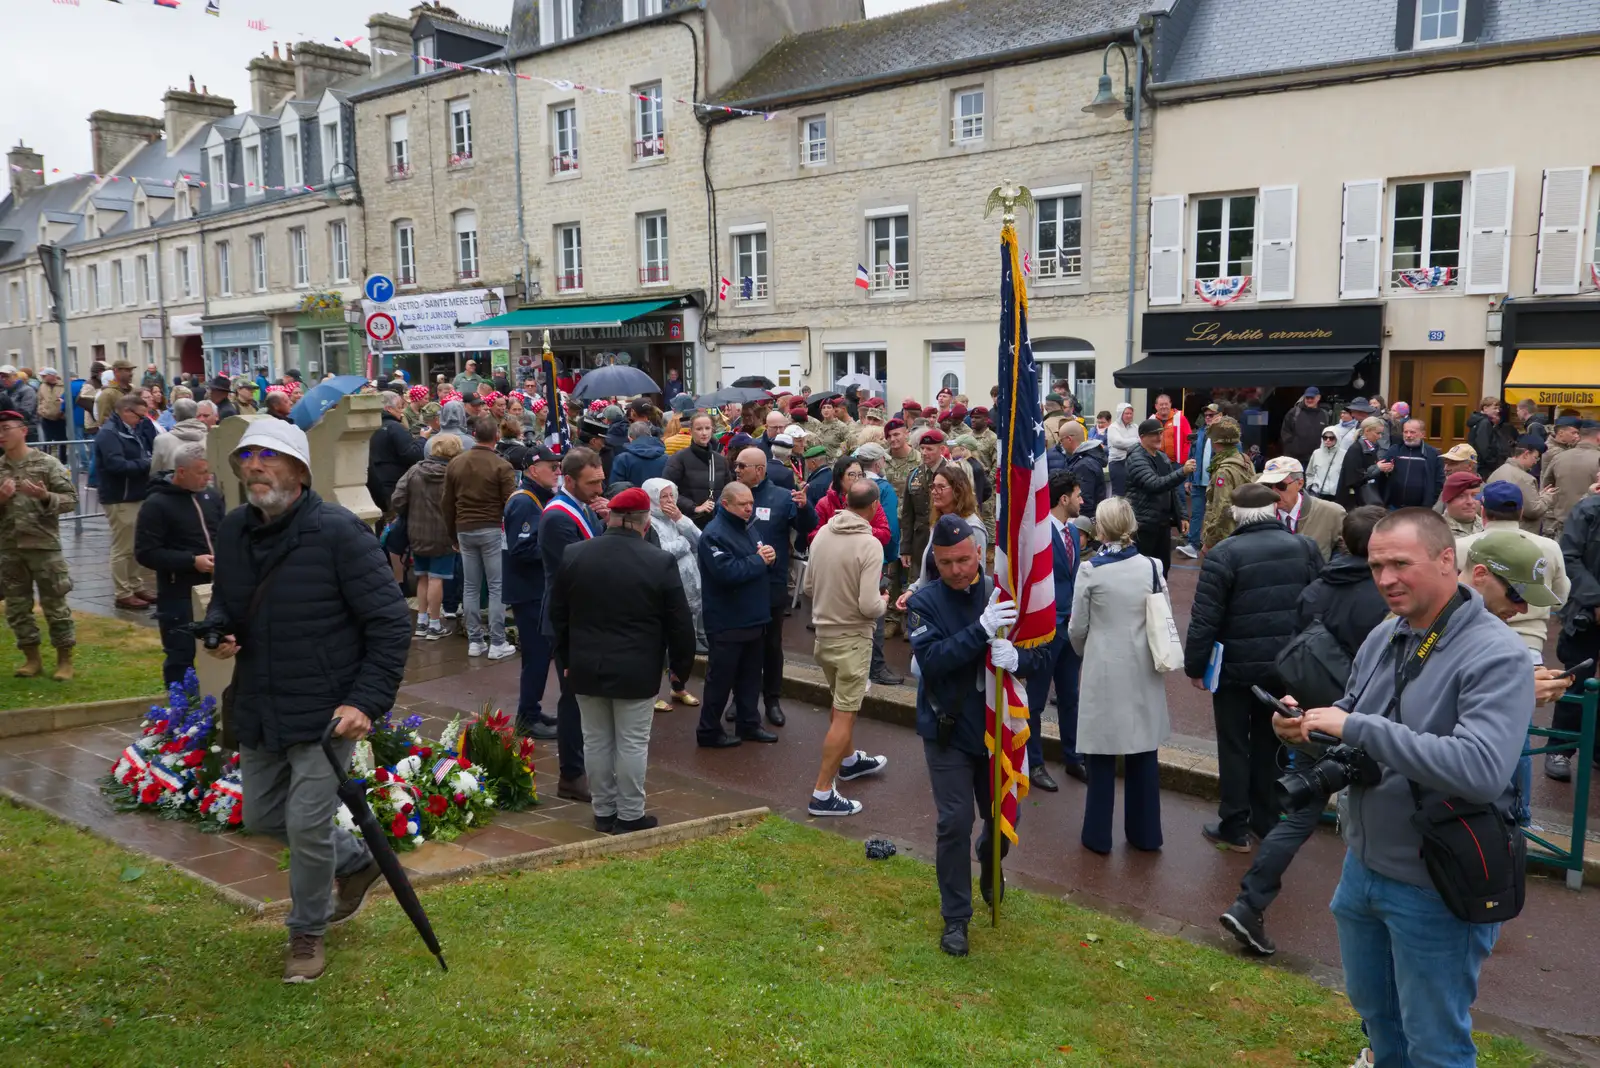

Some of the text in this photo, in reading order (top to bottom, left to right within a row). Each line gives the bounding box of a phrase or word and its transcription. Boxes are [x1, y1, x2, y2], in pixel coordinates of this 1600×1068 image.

[398, 301, 419, 311] RETRO
[425, 299, 448, 309] SAINTE
[449, 297, 469, 307] MERE
[430, 311, 442, 319] JUIN
[563, 327, 596, 340] DEUX
[597, 321, 665, 339] AIRBORNE
[1185, 322, 1333, 346] La petite armoire
[1430, 331, 1442, 340] 39
[1539, 391, 1594, 404] Sandwichs
[1417, 632, 1438, 659] Nikon
